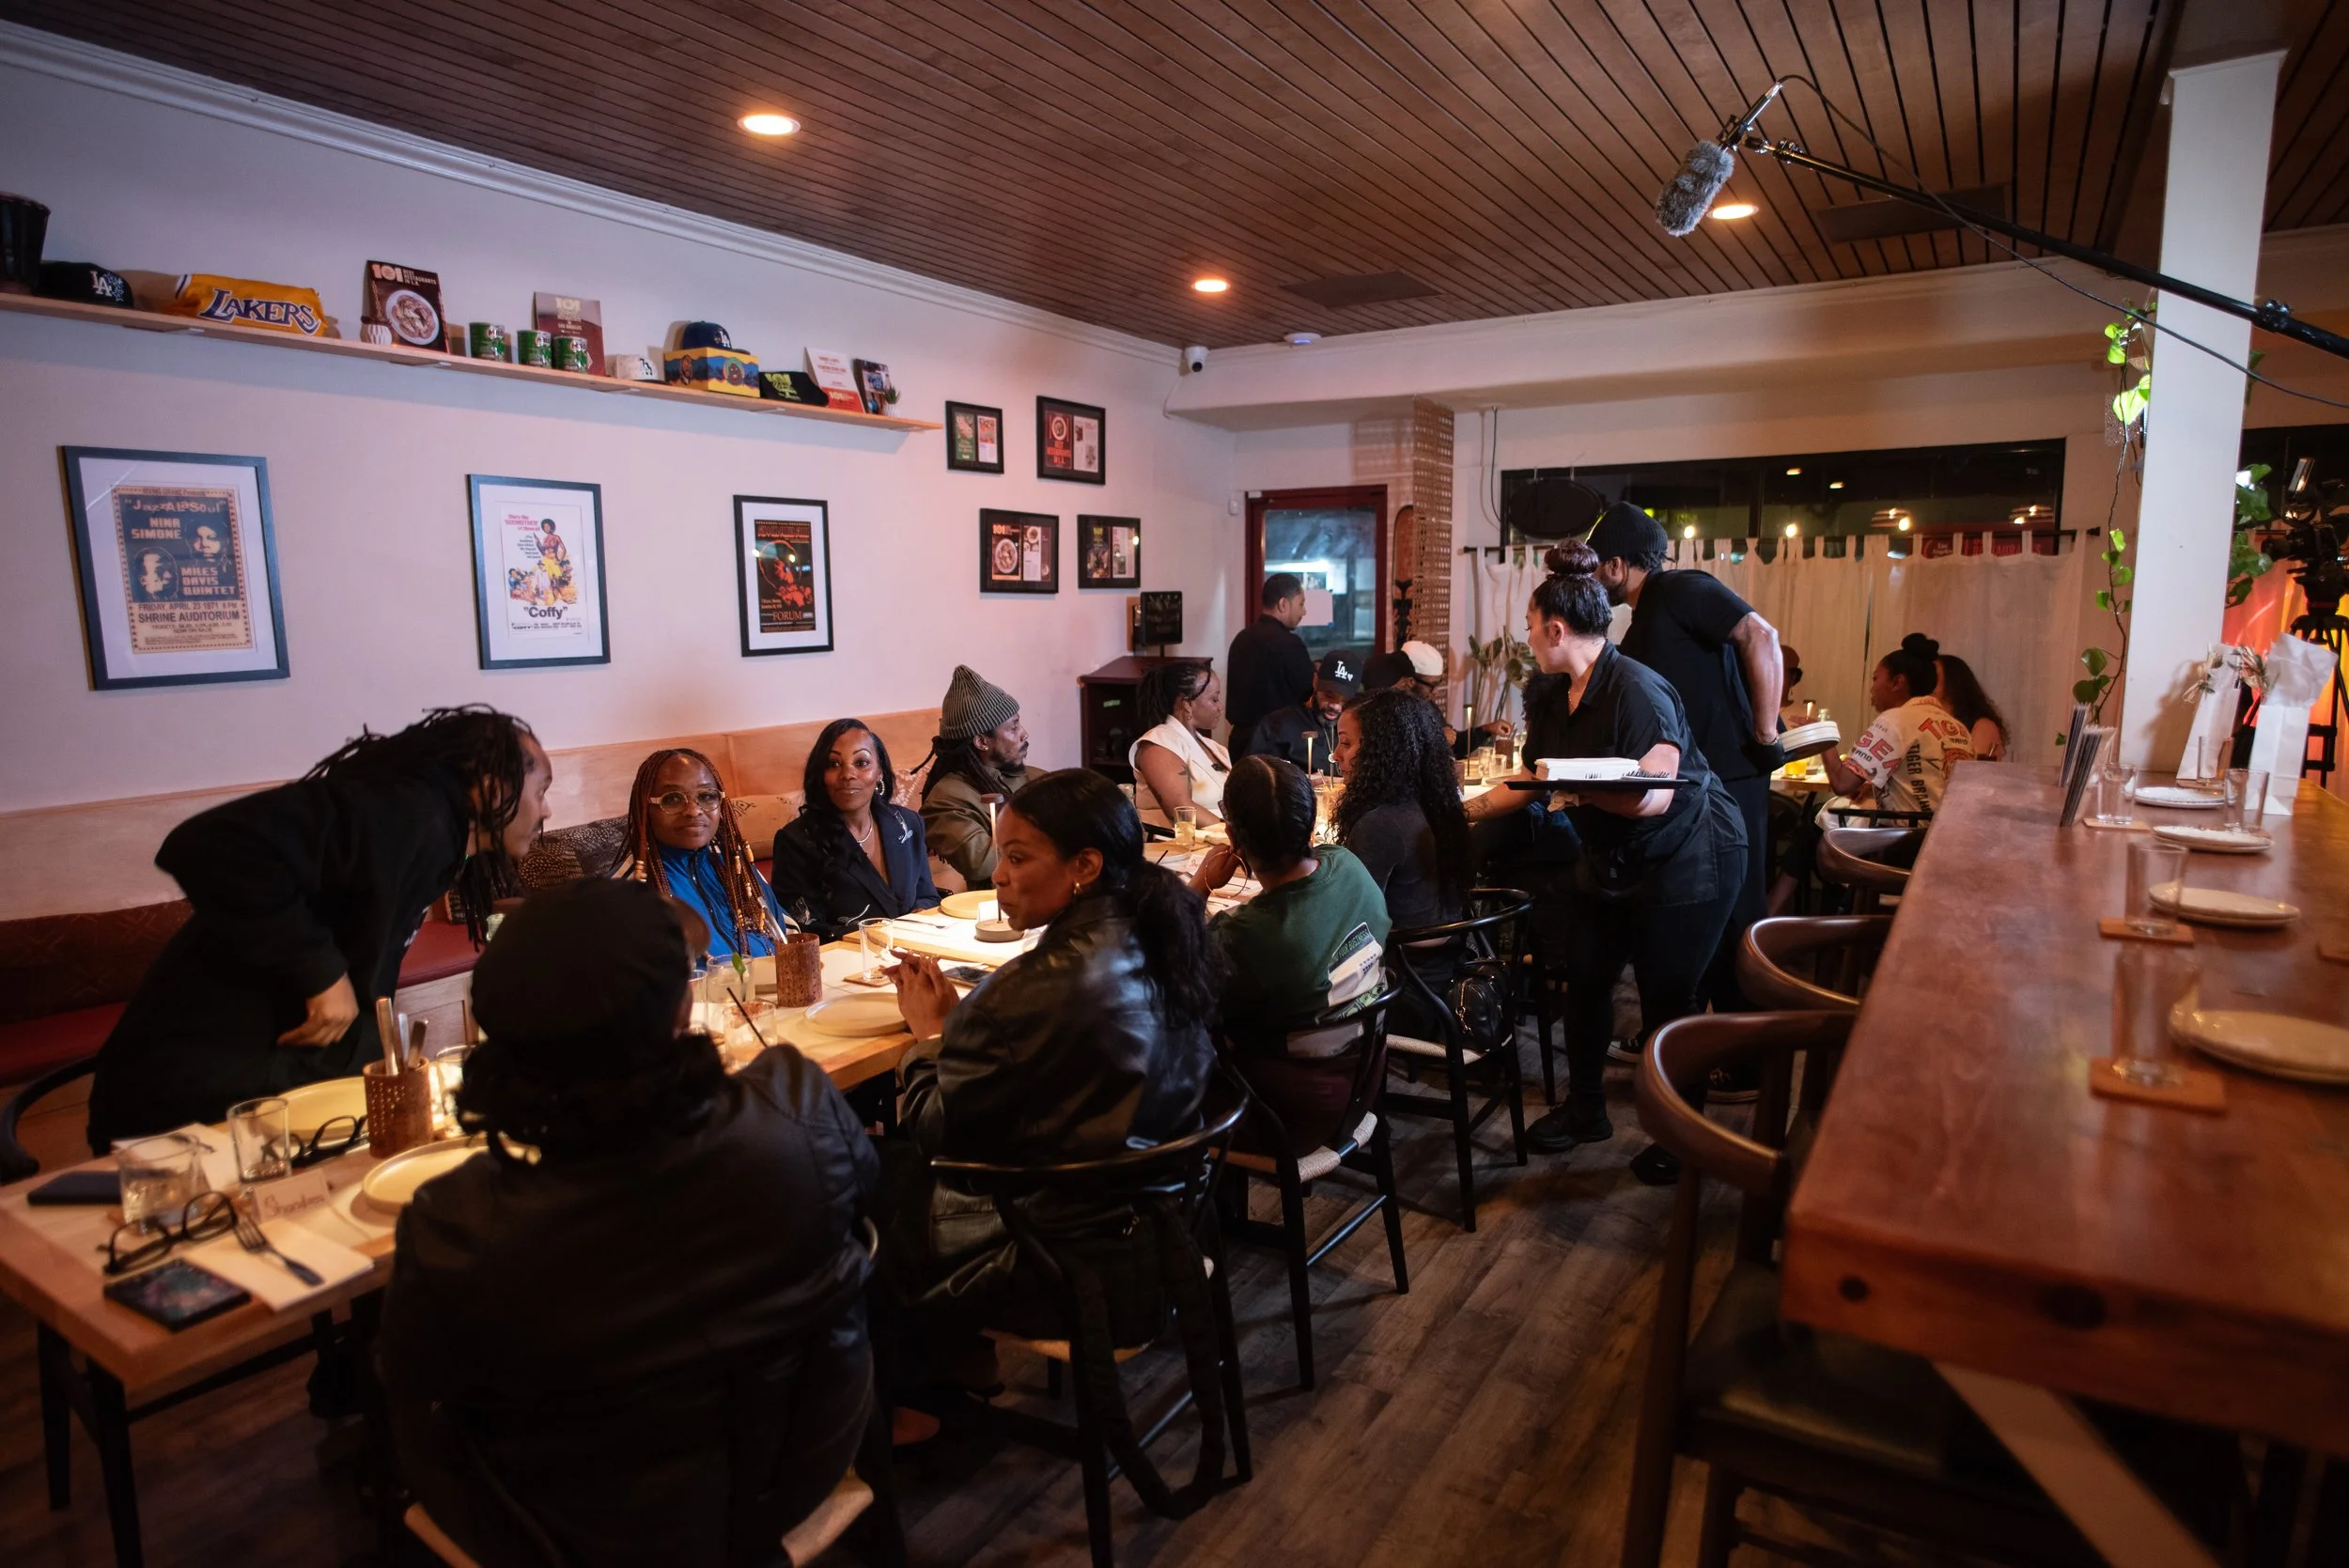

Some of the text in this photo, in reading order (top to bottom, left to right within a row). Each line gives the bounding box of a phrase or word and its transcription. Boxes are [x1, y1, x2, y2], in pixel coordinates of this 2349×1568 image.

[372, 264, 403, 283] 101
[90, 271, 112, 296] LA
[197, 287, 321, 335] LAKERS
[149, 518, 179, 528] NINA
[132, 529, 181, 539] SIMONE
[180, 567, 218, 576] MILES
[182, 577, 218, 586] DAVIS
[183, 586, 235, 596] QUINTET
[169, 602, 191, 611] APRIL
[138, 611, 240, 624] SHRINE AUDITORIUM
[523, 606, 568, 620] "Coffy"
[773, 611, 801, 620] FORUM
[1334, 660, 1347, 679] LA
[1906, 743, 1922, 775] TIGER
